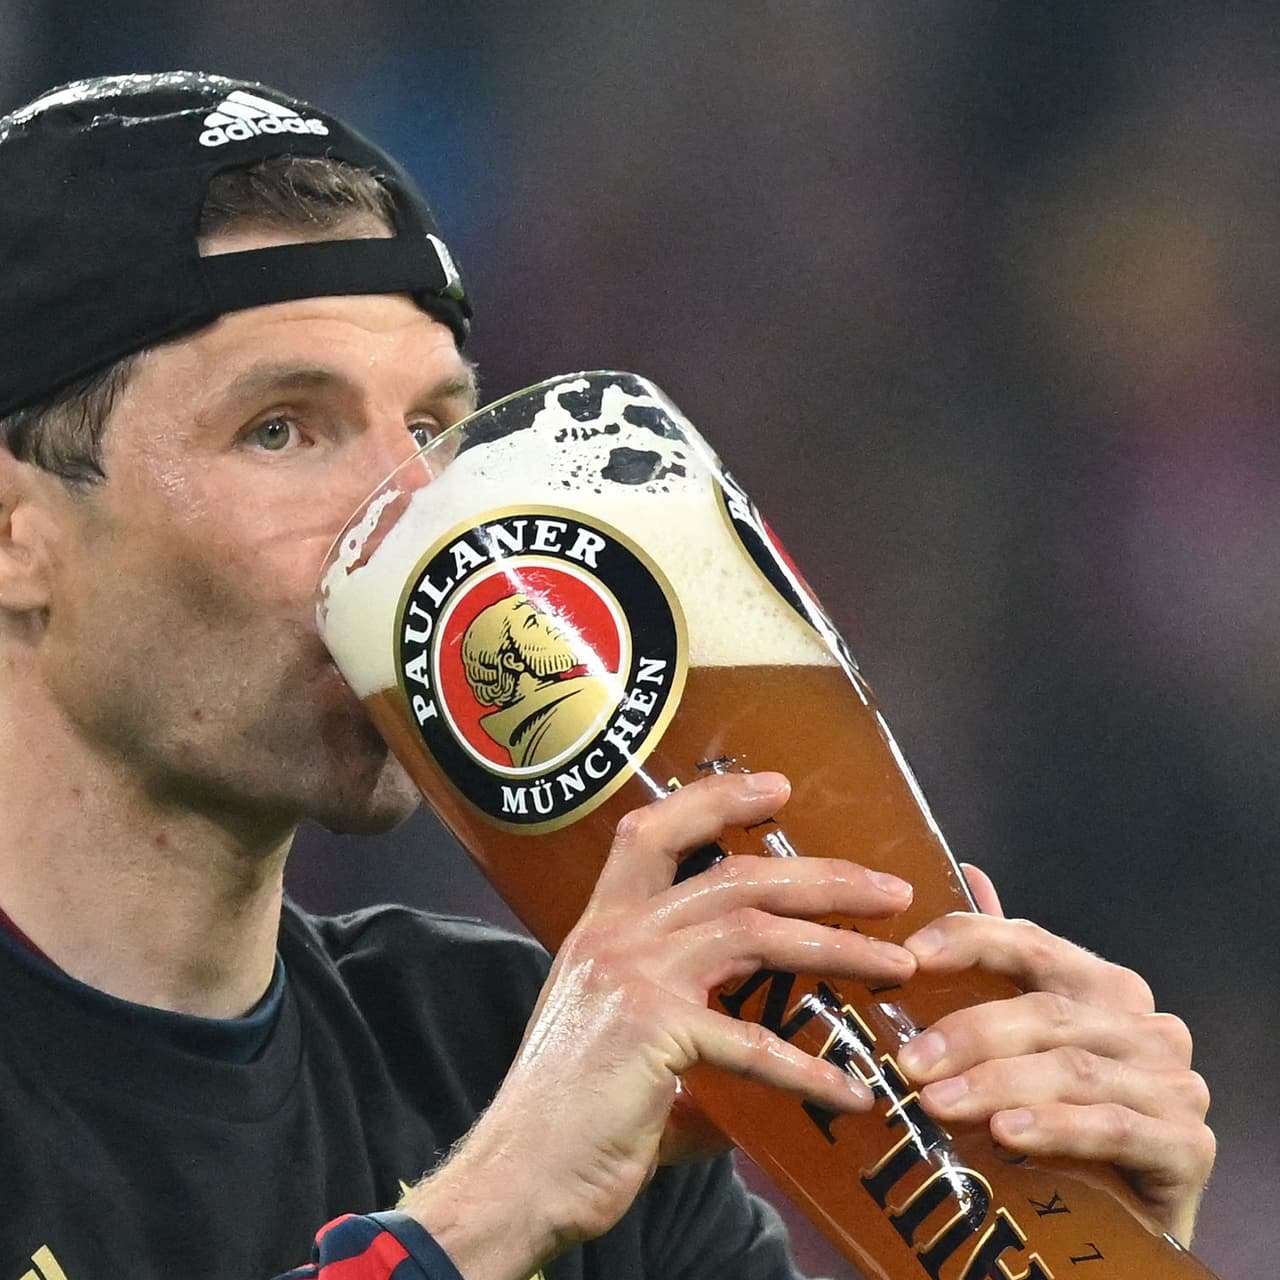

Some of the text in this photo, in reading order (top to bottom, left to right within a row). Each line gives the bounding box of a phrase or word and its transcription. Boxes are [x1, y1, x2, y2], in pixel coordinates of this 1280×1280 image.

[198, 112, 329, 147] adidas
[404, 519, 607, 727] PAULANER
[500, 656, 669, 815] MÜNCHEN
